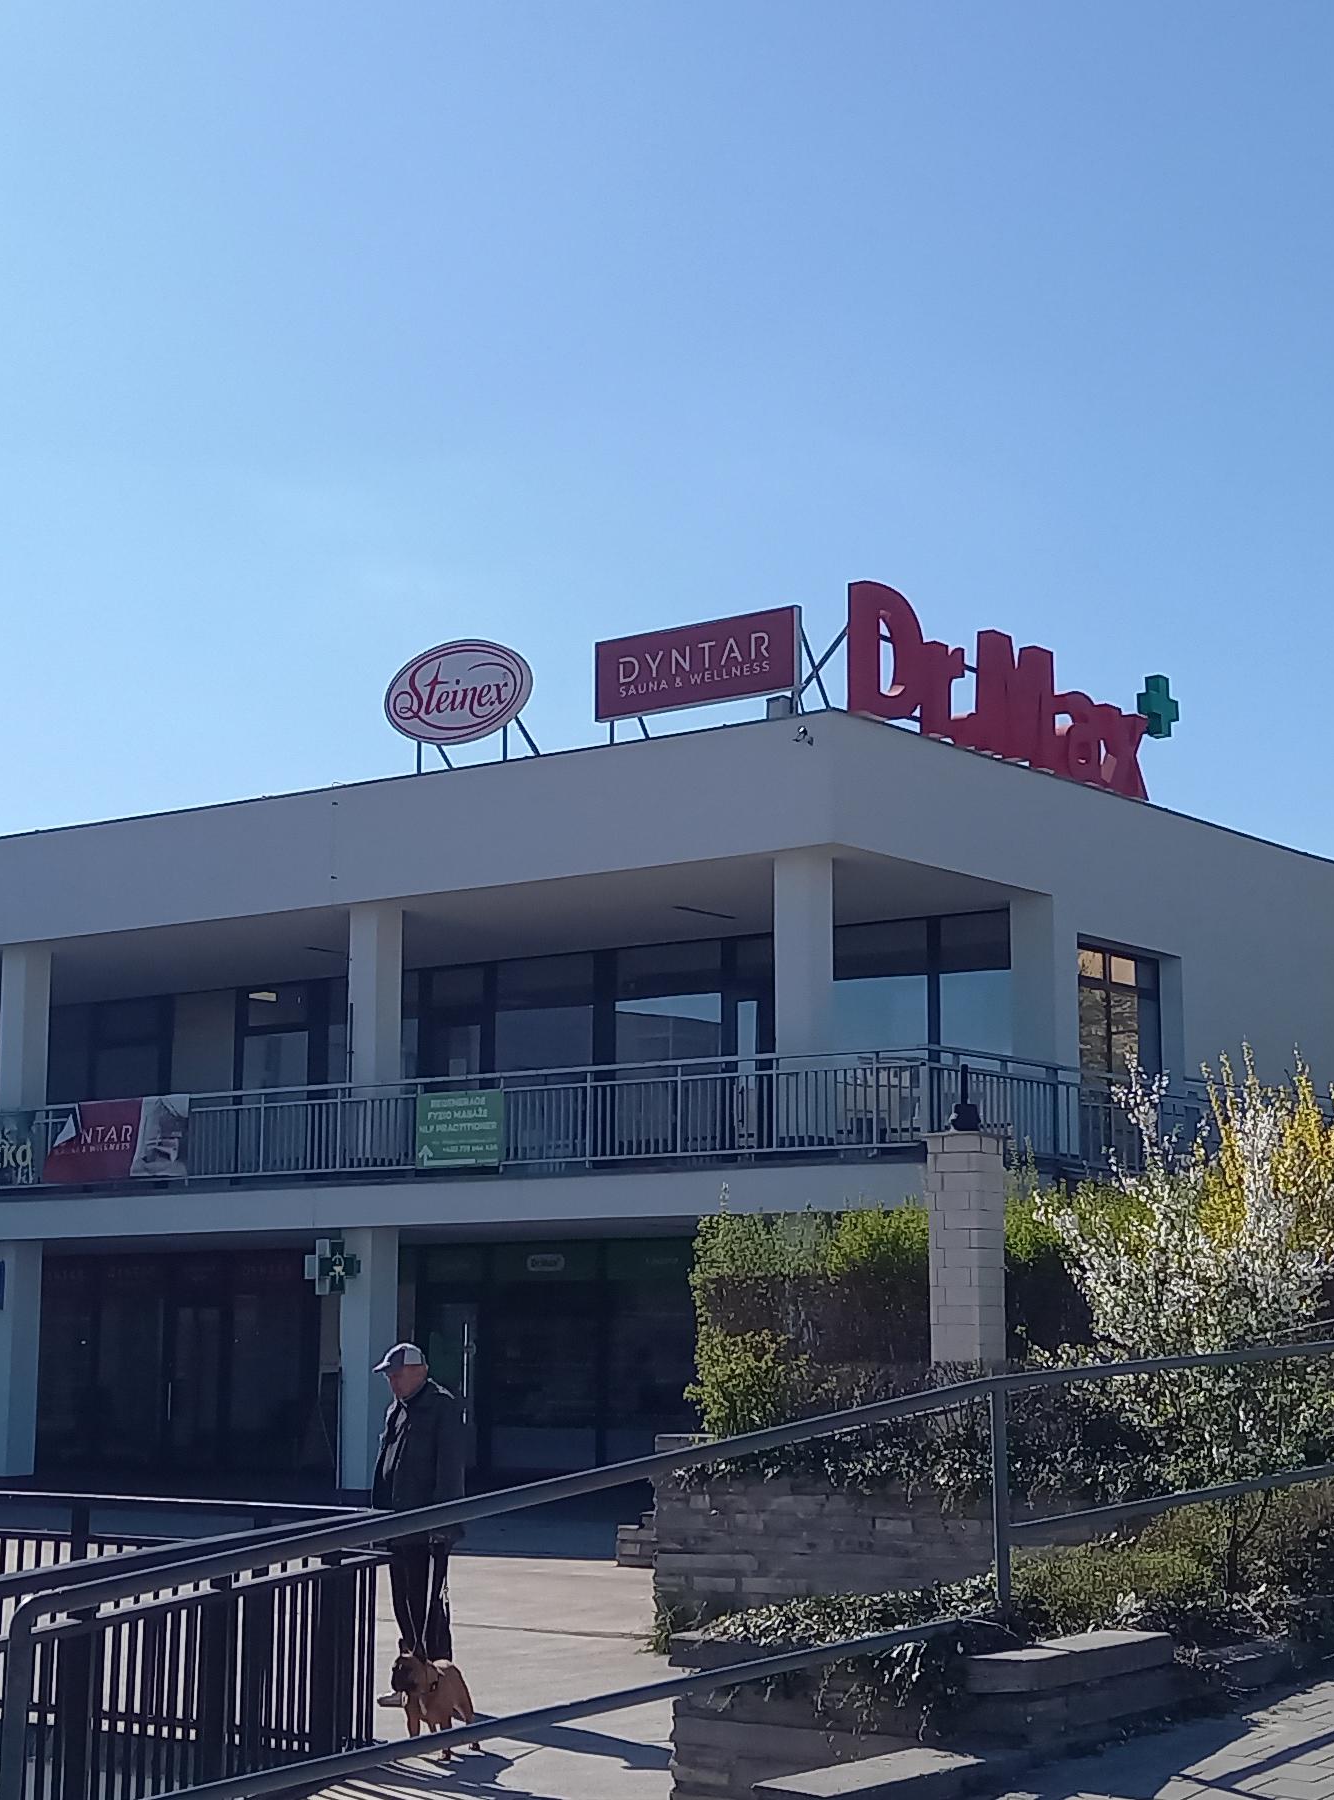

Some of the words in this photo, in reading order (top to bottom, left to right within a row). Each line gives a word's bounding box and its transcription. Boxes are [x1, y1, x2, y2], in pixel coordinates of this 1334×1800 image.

[618, 631, 771, 685] DYNTAR
[618, 679, 669, 699] SAUNA
[674, 676, 684, 689] &
[689, 660, 771, 687] WELLNESS
[392, 657, 509, 720] Steinex
[79, 1125, 133, 1145] NTAR
